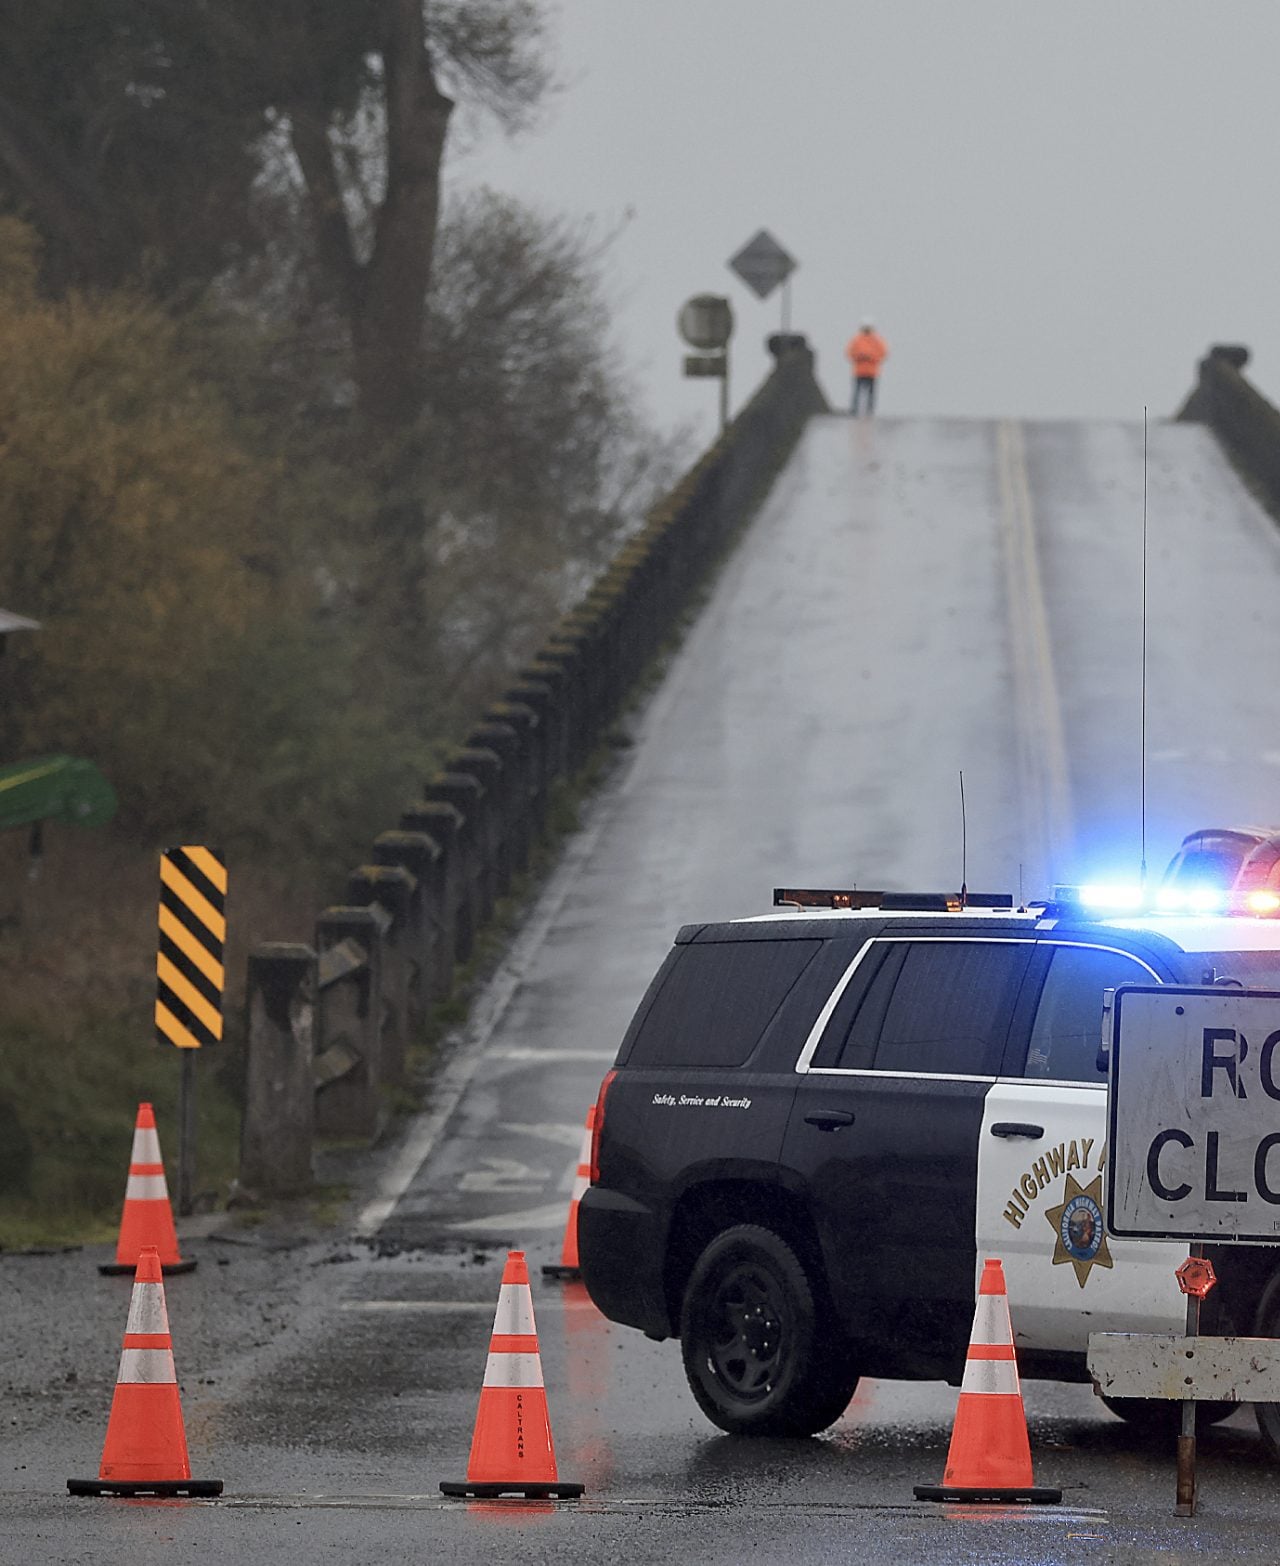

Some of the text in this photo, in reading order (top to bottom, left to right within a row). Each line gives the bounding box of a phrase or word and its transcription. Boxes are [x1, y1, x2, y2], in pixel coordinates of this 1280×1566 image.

[652, 1093, 752, 1109] Safety, Service and Security
[1003, 1139, 1094, 1230] HIGHWAY
[516, 1394, 524, 1458] CALTRANS
